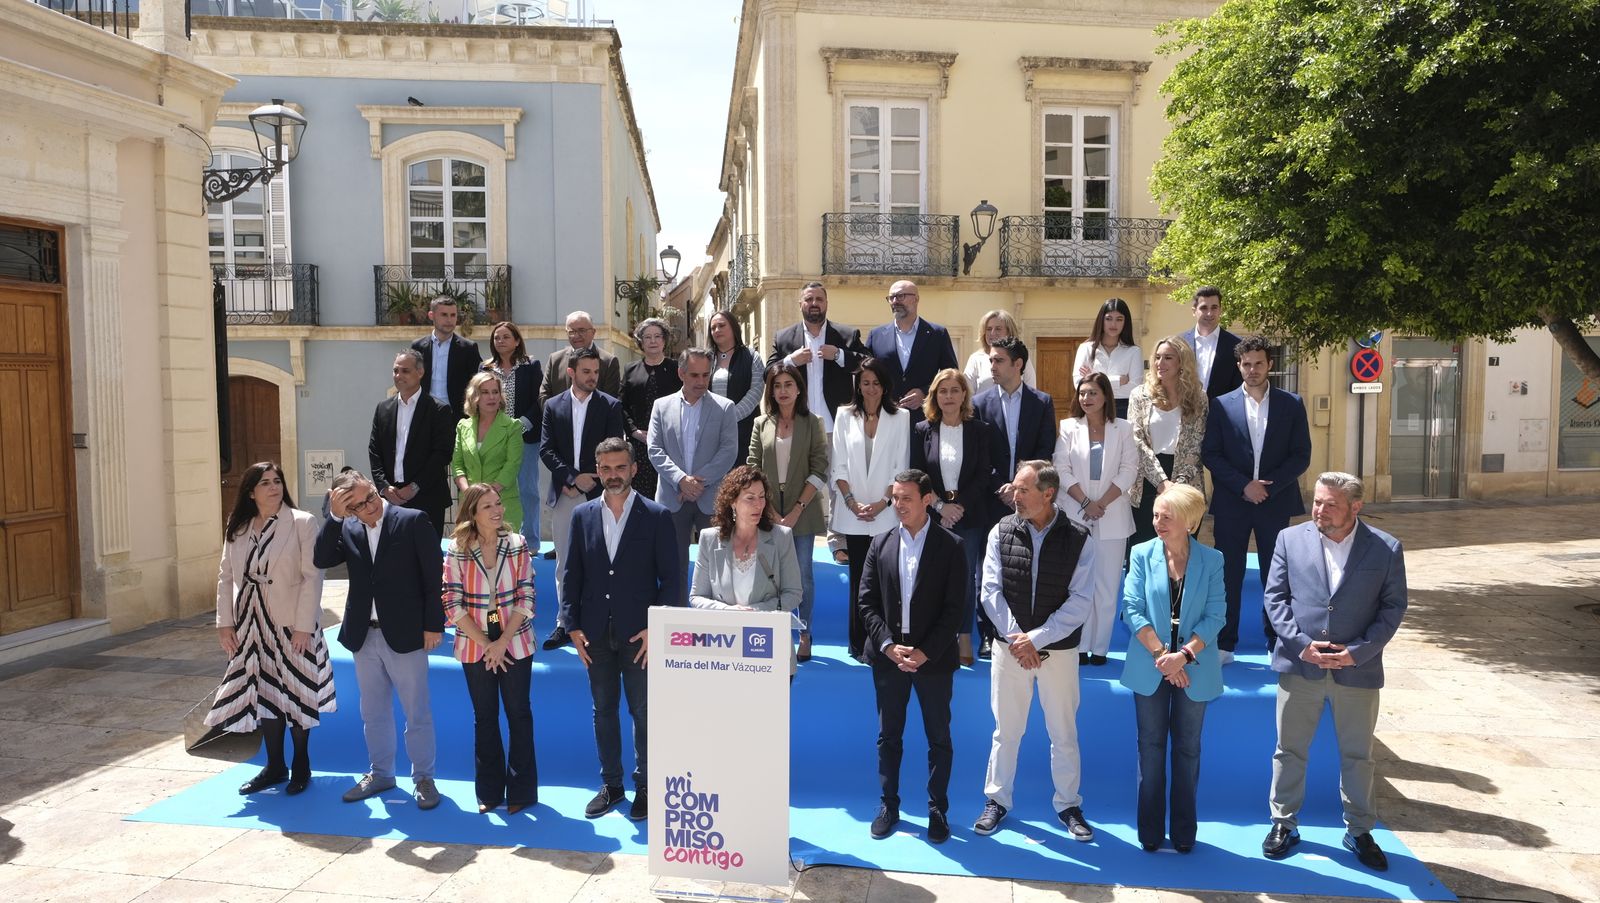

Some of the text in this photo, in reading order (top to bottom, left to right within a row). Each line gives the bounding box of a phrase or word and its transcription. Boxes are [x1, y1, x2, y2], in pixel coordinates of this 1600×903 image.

[1492, 357, 1498, 366] 7
[670, 632, 736, 648] 28MMV
[665, 658, 772, 674] María del Mar Vázquez
[665, 771, 692, 793] mi
[664, 790, 719, 813] COM
[665, 809, 714, 831] PRO
[665, 828, 725, 851] MISO
[663, 844, 744, 871] contigo
